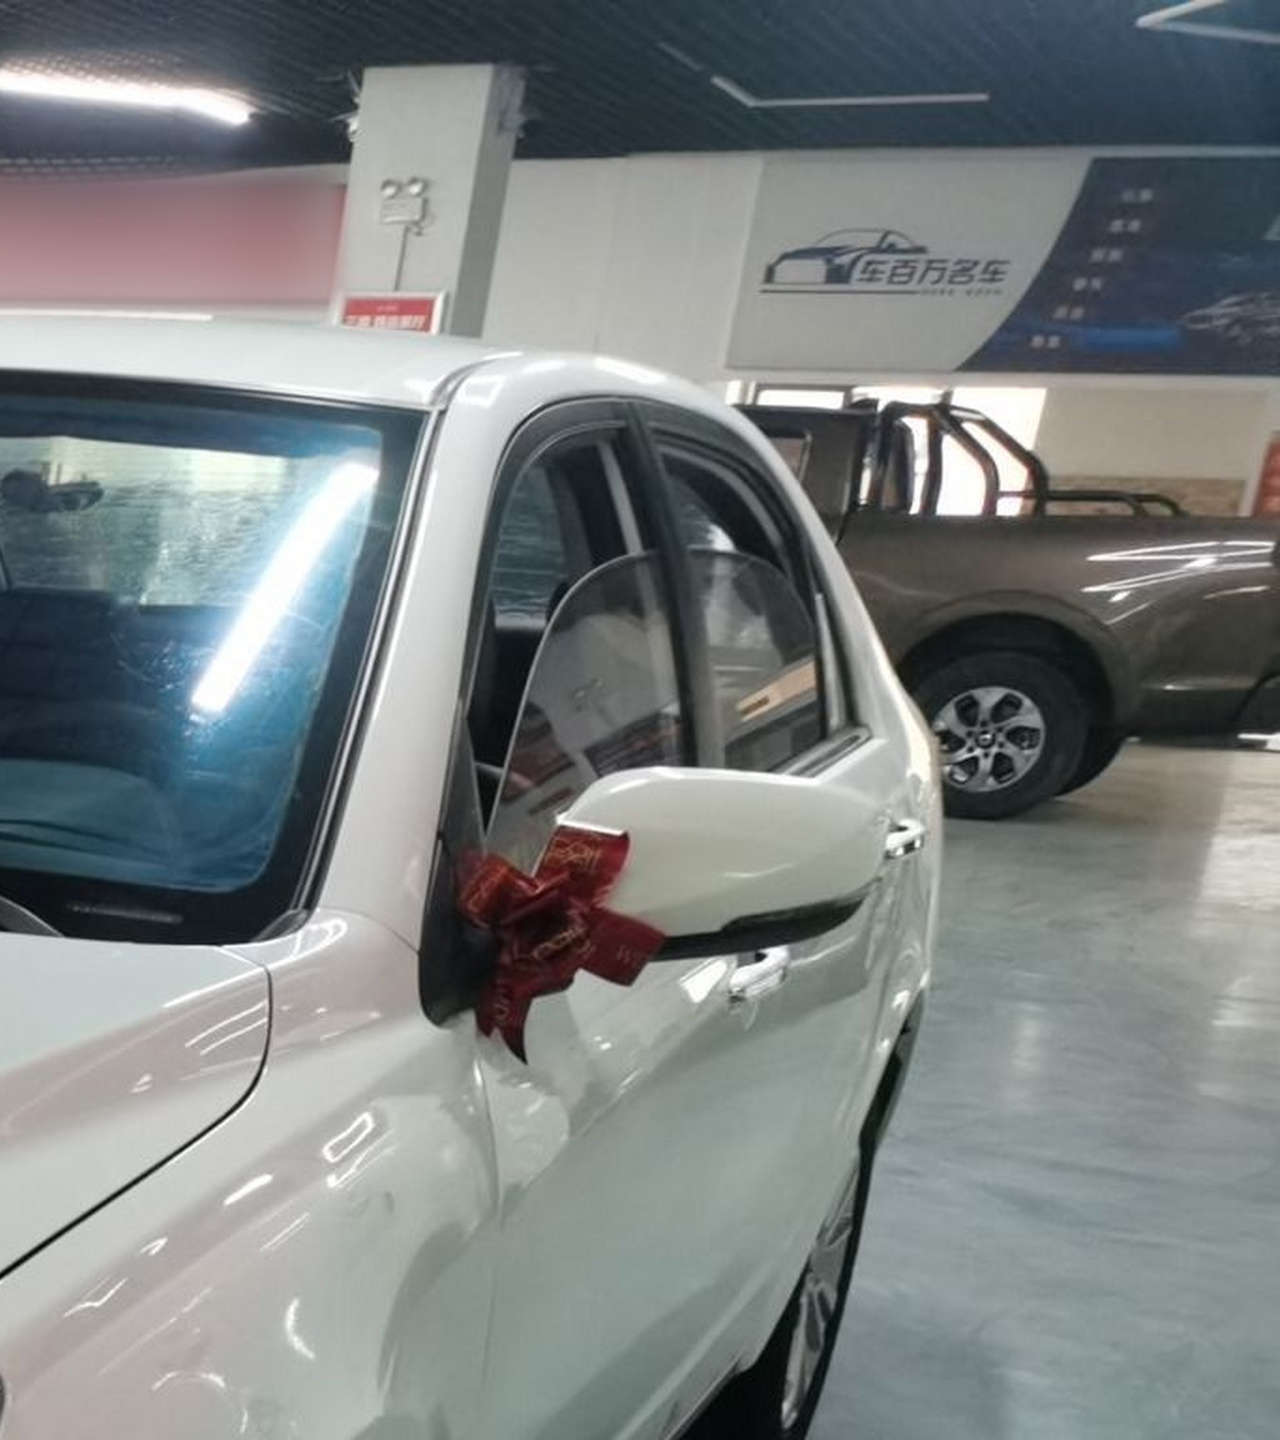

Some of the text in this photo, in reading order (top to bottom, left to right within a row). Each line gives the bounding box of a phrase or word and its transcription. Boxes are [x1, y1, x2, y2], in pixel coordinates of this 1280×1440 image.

[857, 259, 1010, 285] 车百万名车
